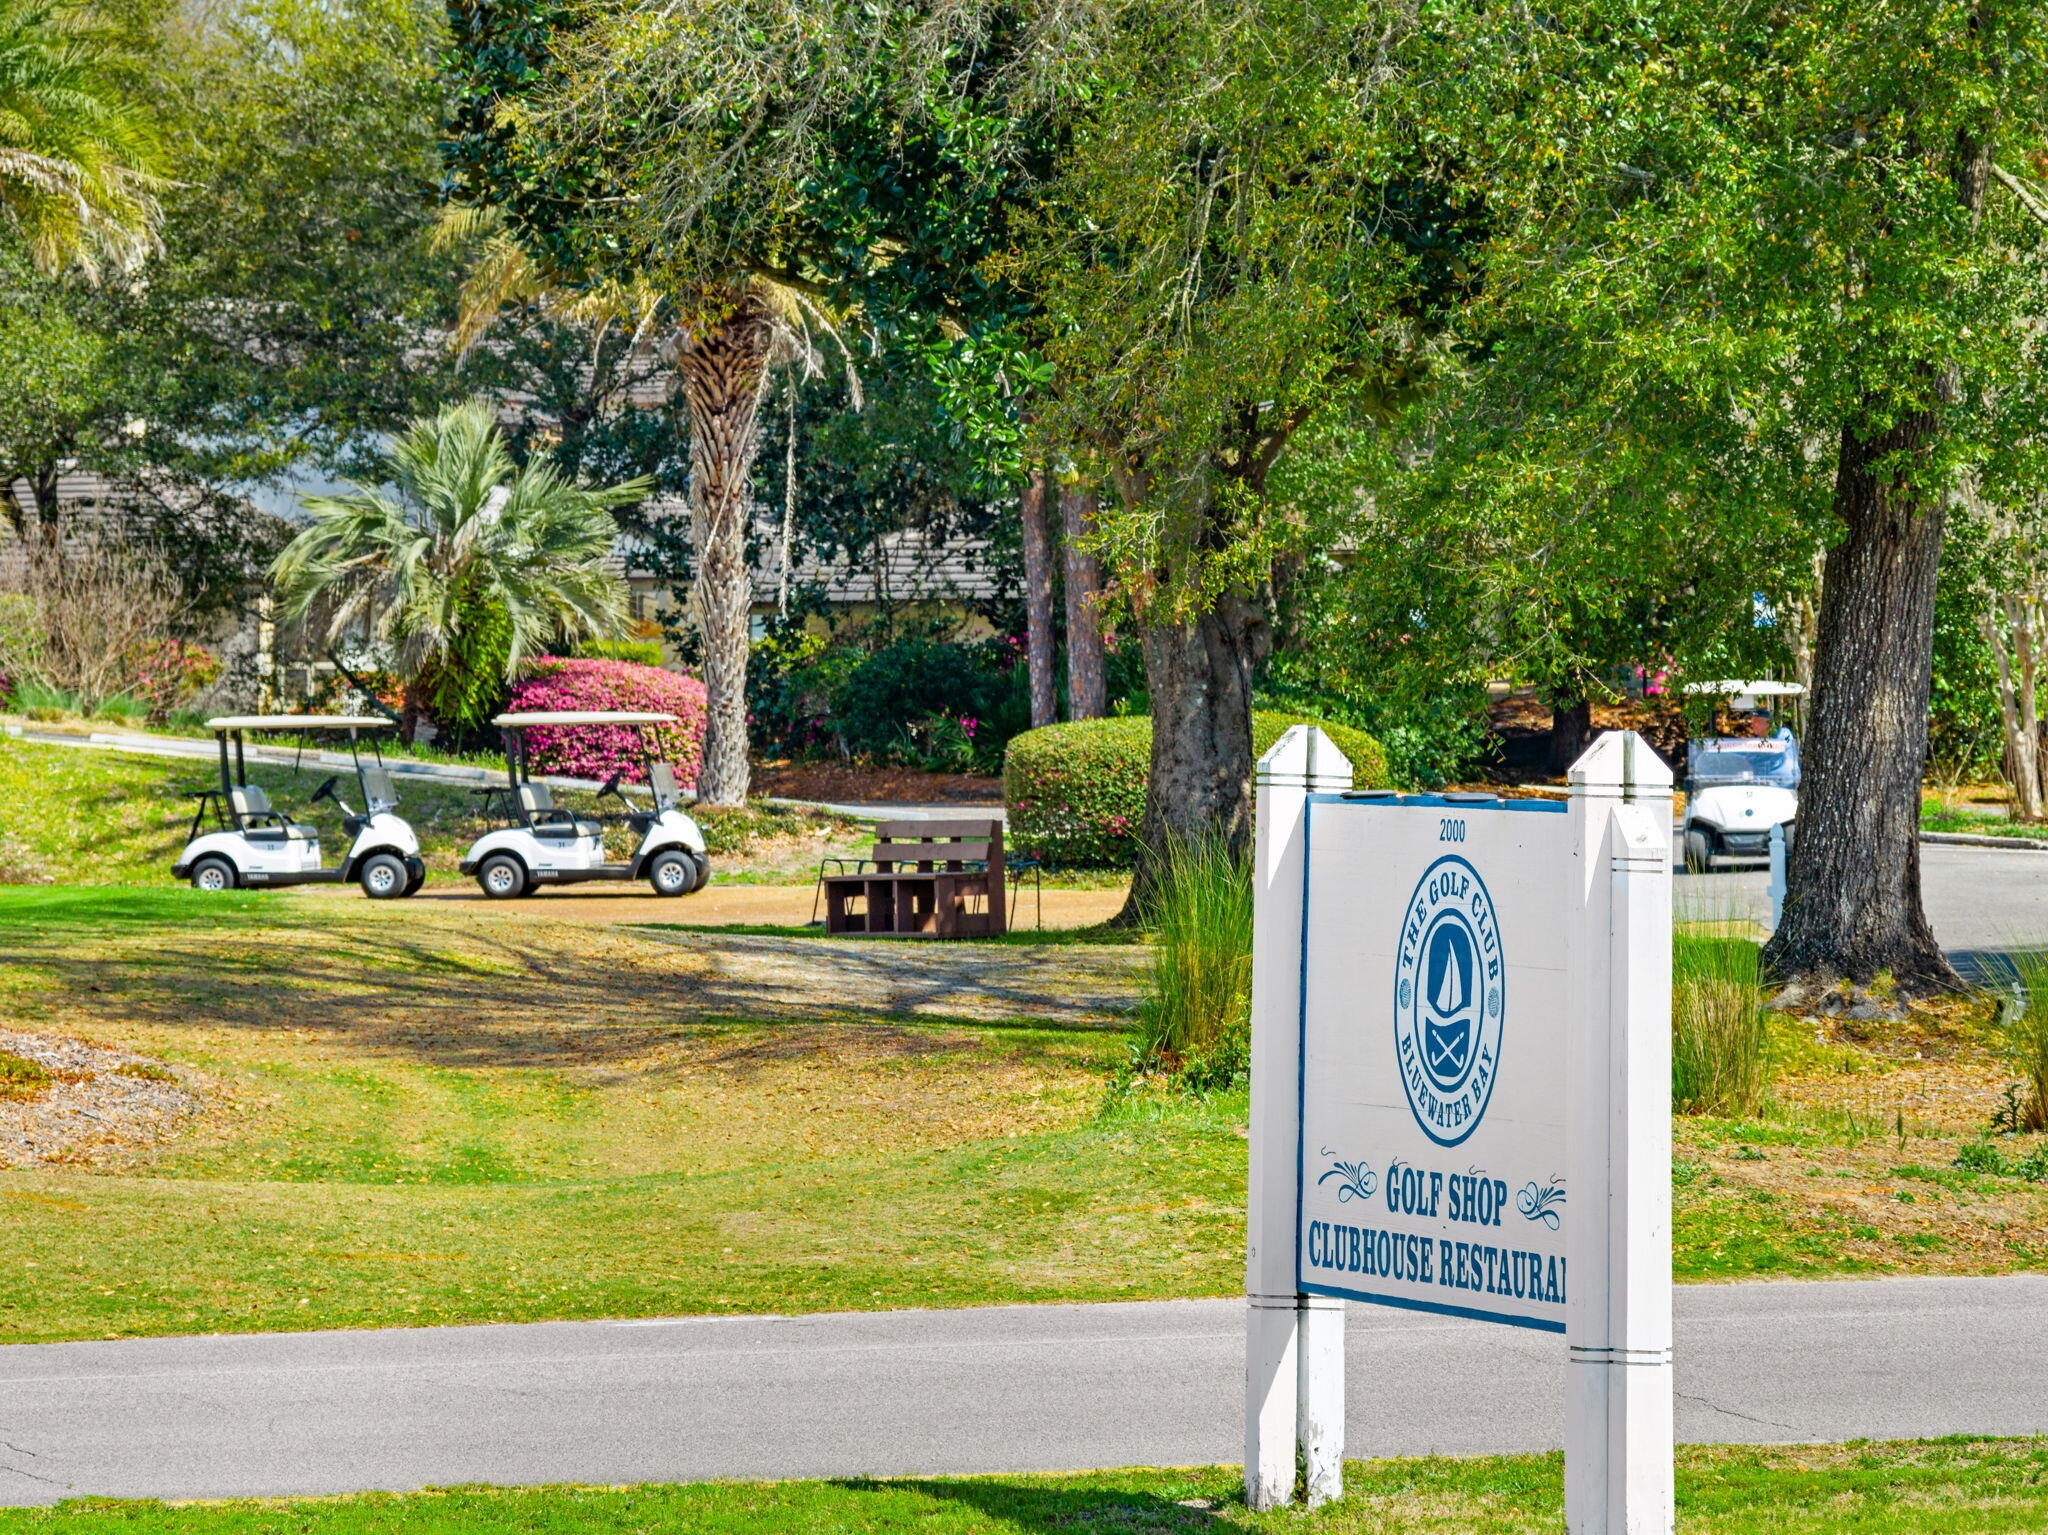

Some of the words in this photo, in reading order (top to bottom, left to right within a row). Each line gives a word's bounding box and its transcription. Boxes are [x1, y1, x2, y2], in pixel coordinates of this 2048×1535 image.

[1439, 818, 1466, 843] 2000
[1402, 899, 1428, 971] THE
[1428, 871, 1470, 906] GOLF
[1471, 892, 1499, 981] CLUB
[1401, 1035, 1473, 1129] BLUEWATER
[1472, 1042, 1494, 1104] BAY
[1386, 1164, 1443, 1217] GOLF
[1448, 1173, 1508, 1227] SHOP
[1308, 1220, 1434, 1284] CLUBHOUSE
